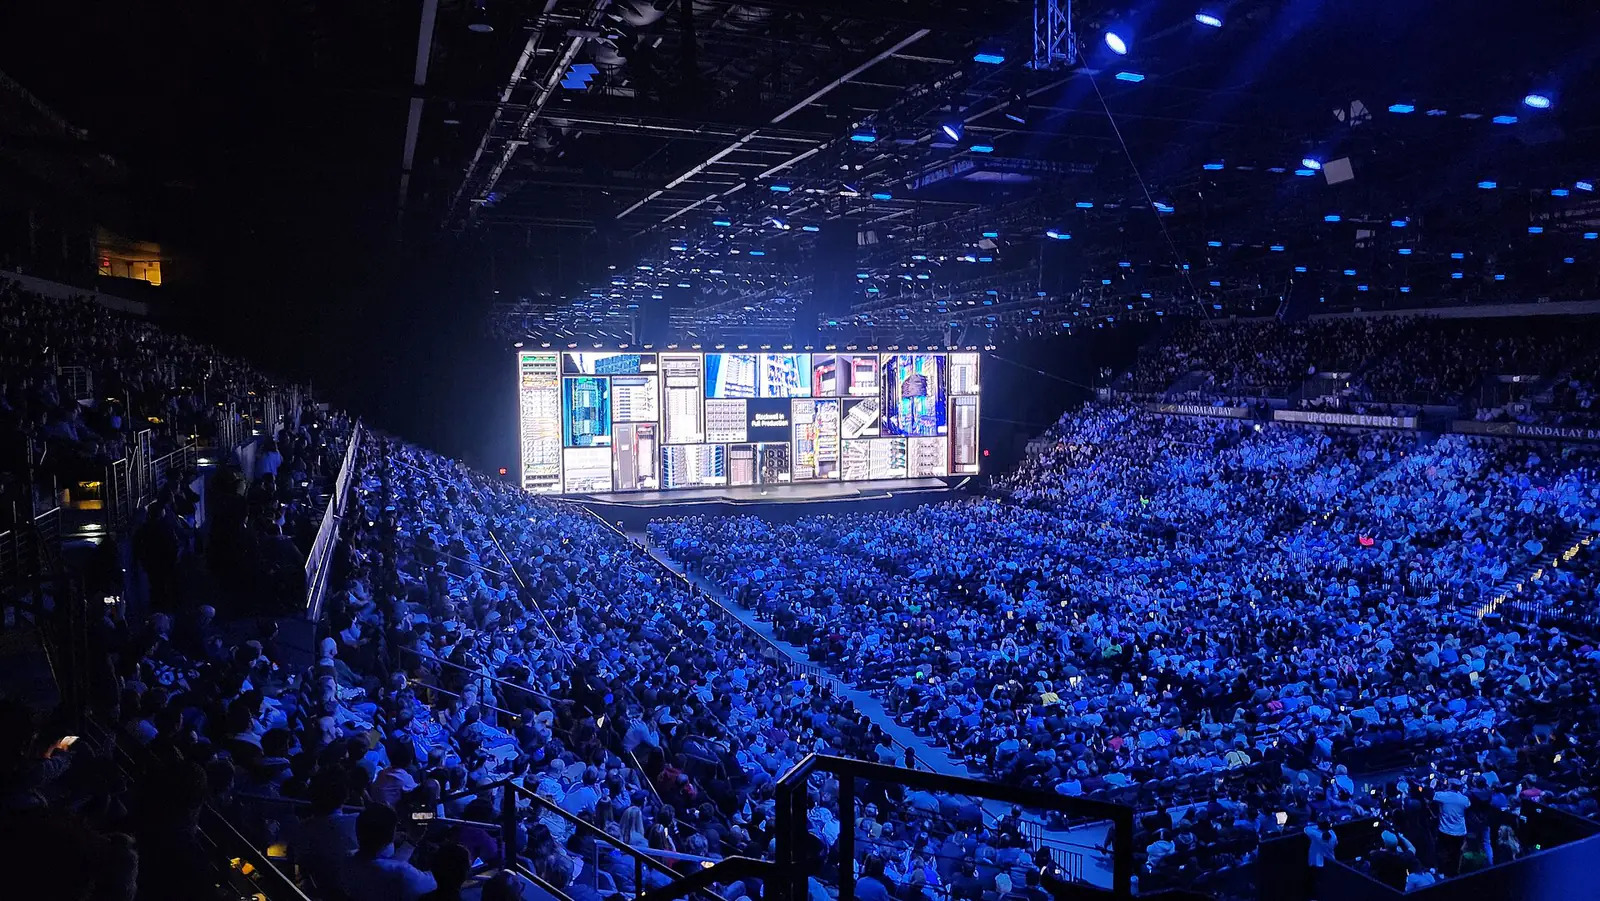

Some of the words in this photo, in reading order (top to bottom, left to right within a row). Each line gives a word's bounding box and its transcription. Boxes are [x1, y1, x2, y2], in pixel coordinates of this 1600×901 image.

[1177, 404, 1217, 415] MANDALAY
[1218, 406, 1232, 416] BAY
[1307, 412, 1357, 425] UPCOMING
[1360, 416, 1398, 427] EVENTS
[1516, 424, 1584, 438] MANDALAY
[1587, 428, 1600, 439] BA
